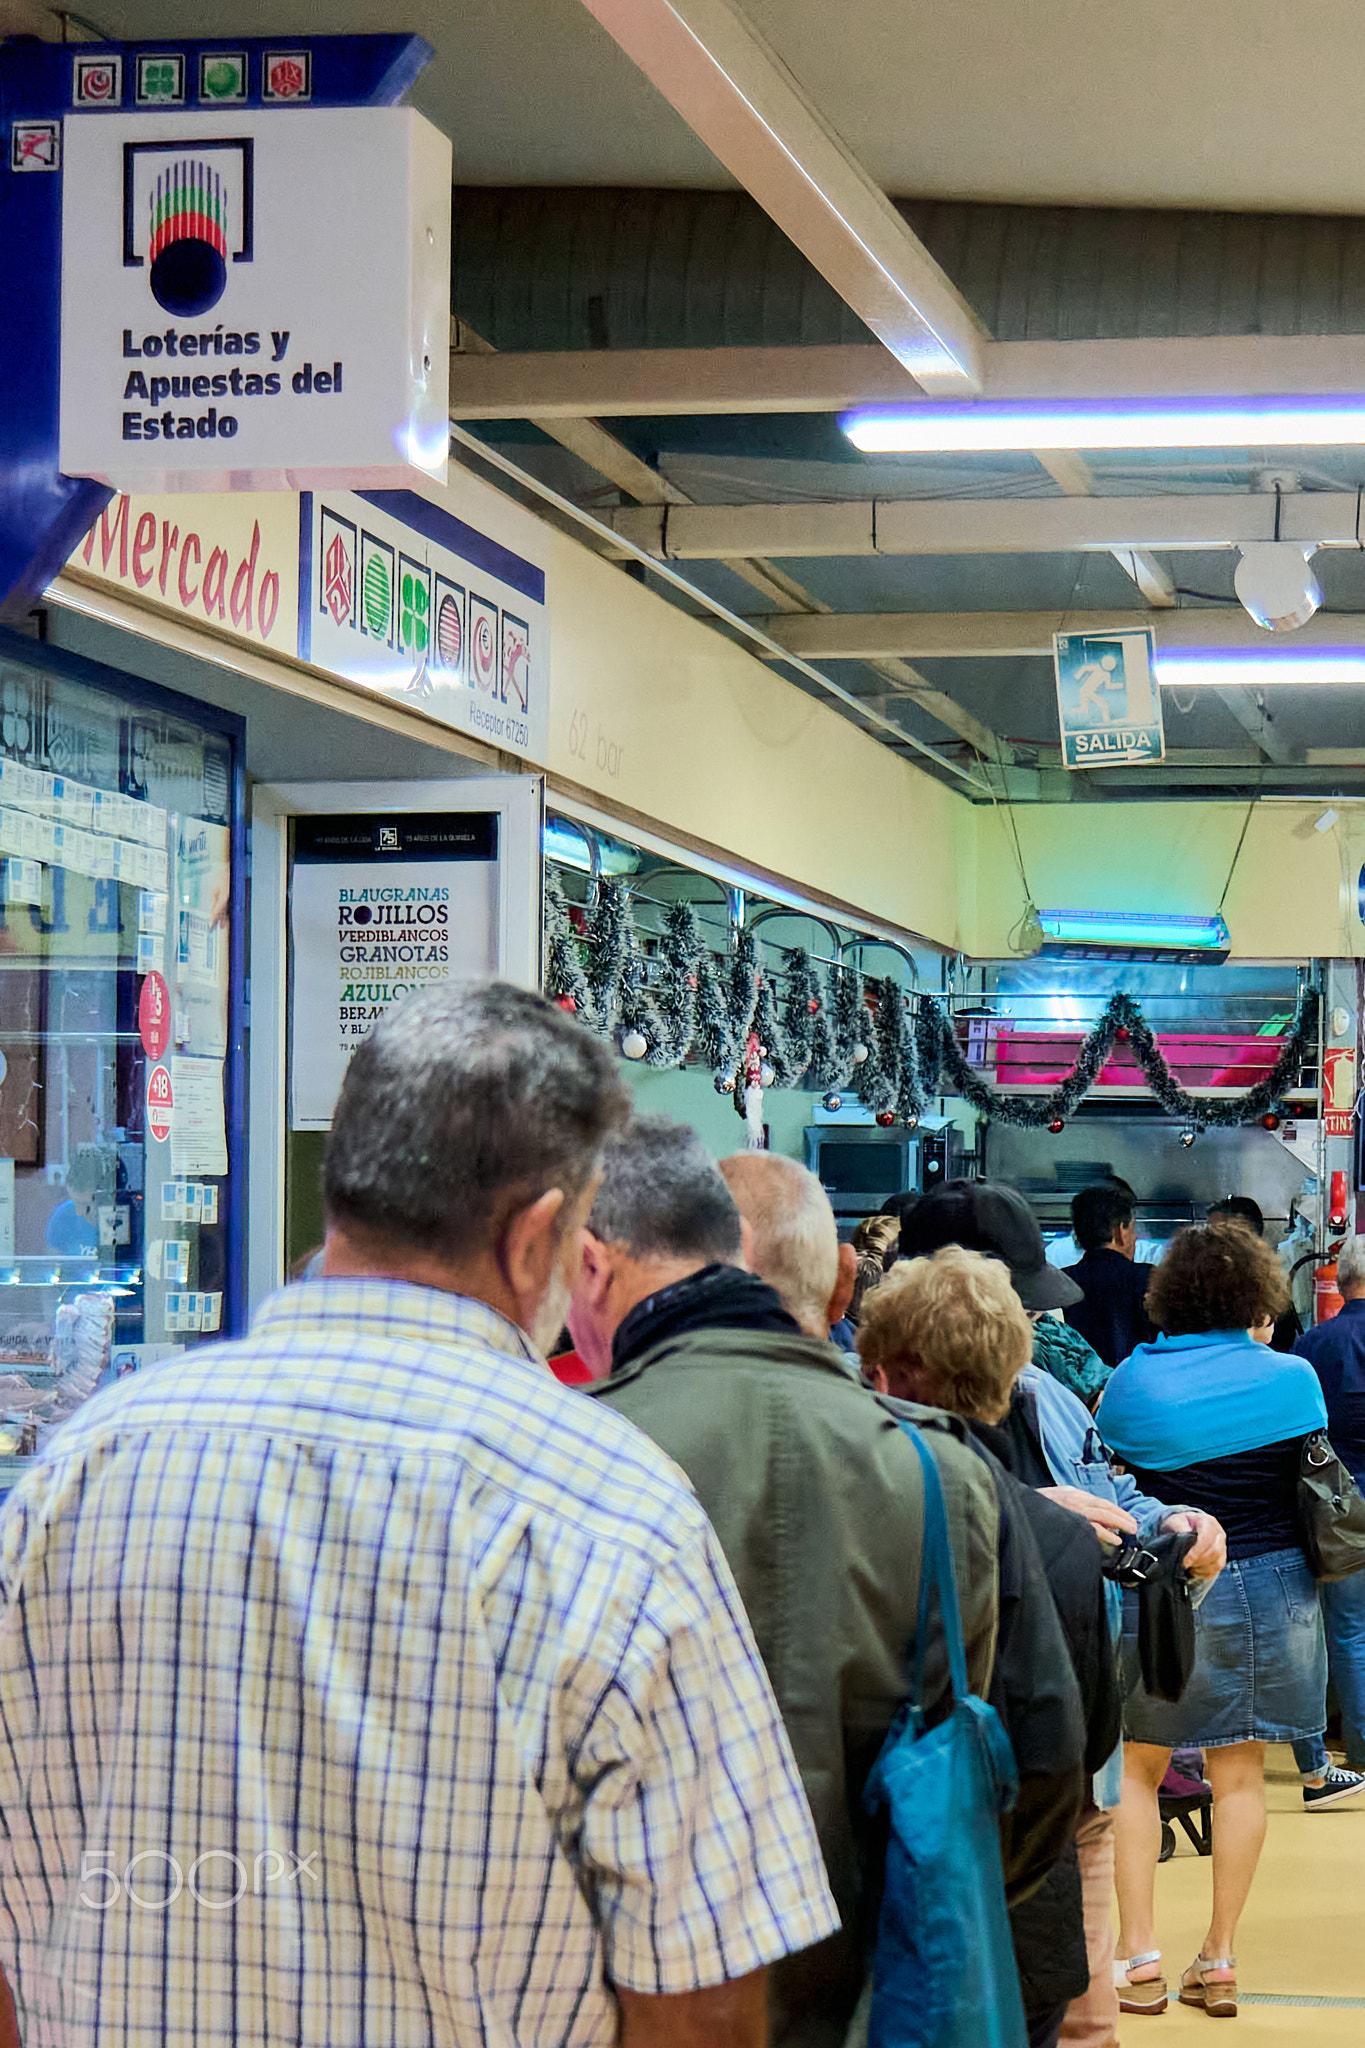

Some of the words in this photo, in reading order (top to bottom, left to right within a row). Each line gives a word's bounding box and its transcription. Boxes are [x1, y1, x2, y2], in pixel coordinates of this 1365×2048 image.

[122, 324, 261, 358] Loterías
[271, 329, 290, 361] y
[123, 366, 281, 406] Apuestas
[292, 362, 343, 395] del
[122, 408, 239, 441] Estado
[82, 494, 280, 640] Mercado
[469, 700, 504, 736] Receptor
[506, 717, 529, 748] 67250
[569, 708, 588, 760] 62
[596, 723, 624, 779] bar
[1075, 730, 1152, 753] SALIDA
[382, 830, 395, 844] 75
[339, 887, 450, 903] BLAUGRANAS
[338, 929, 449, 943] VERDIBLANCOS
[339, 945, 449, 963] GRANOTAS
[339, 965, 449, 980] ROJIBLANCOS
[340, 983, 436, 1002] AZULO
[339, 1006, 388, 1020] BERM
[340, 1024, 347, 1034] Y
[148, 1074, 168, 1098] +18
